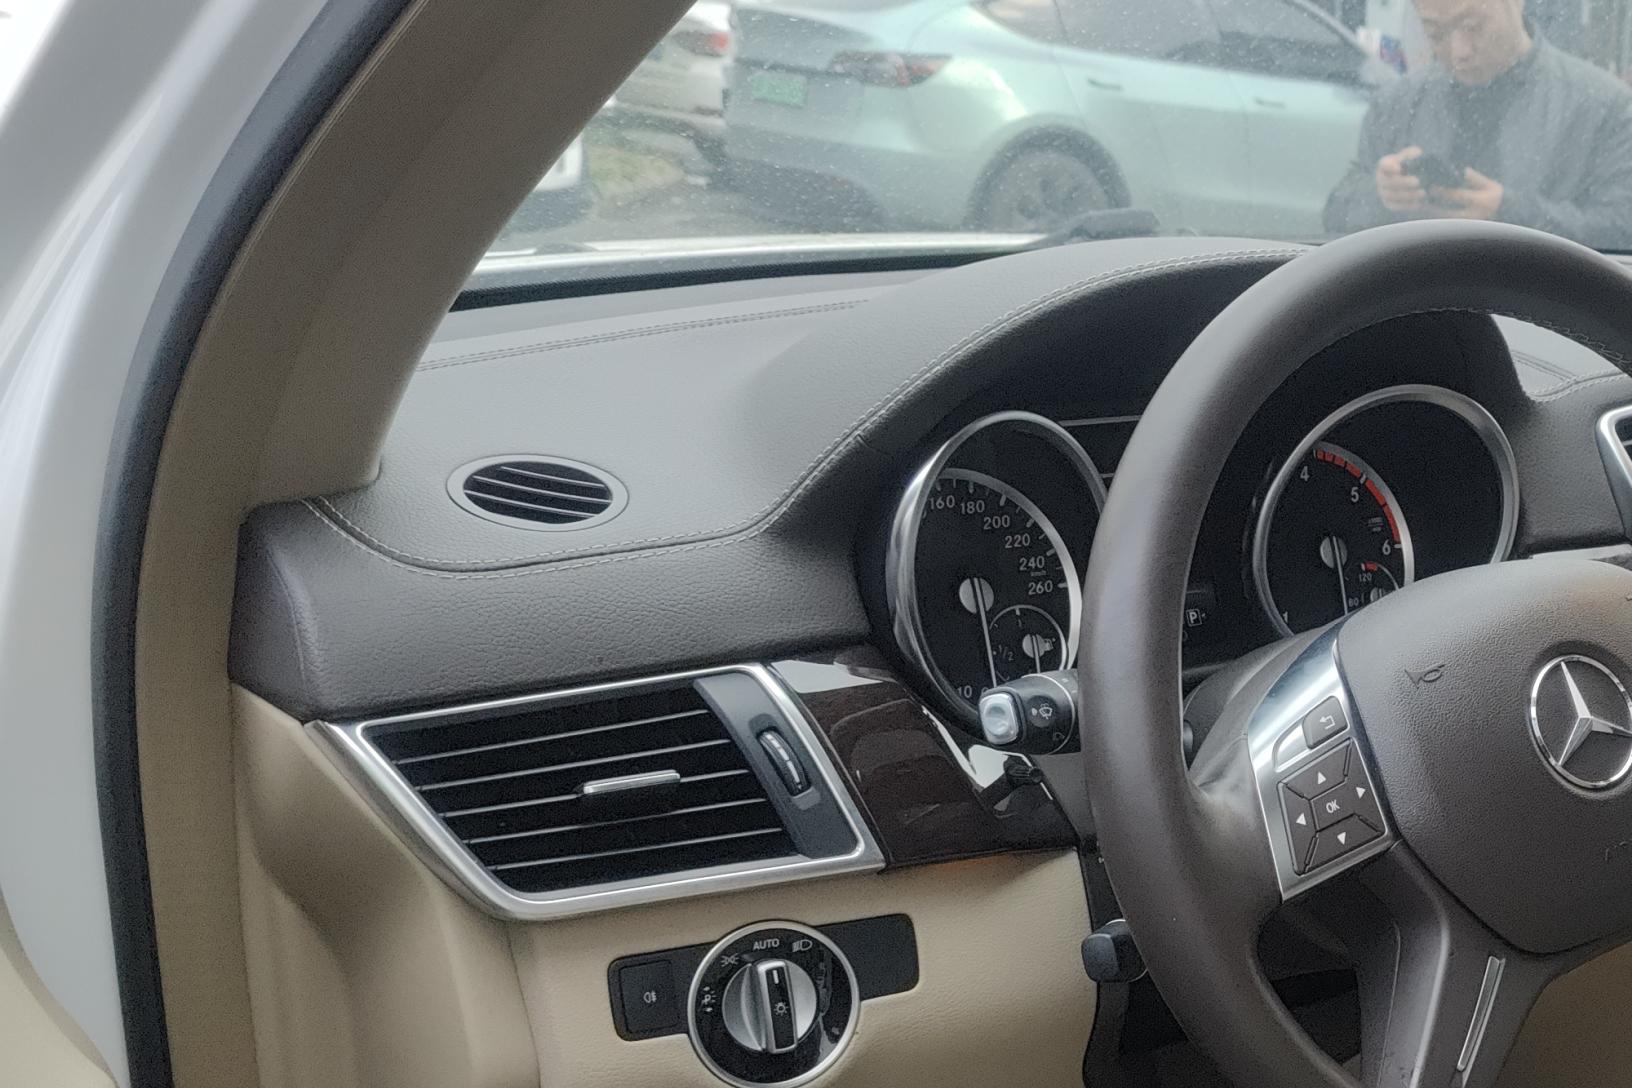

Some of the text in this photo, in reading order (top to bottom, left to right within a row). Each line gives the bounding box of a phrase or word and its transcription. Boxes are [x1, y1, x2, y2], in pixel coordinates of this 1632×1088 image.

[1300, 465, 1310, 482] 4
[929, 494, 955, 510] 160
[1350, 486, 1360, 503] 5
[960, 499, 985, 515] 180
[983, 514, 1010, 530] 200
[1004, 533, 1031, 549] 220
[1381, 539, 1391, 556] 6
[1018, 555, 1045, 571] 240
[1358, 572, 1373, 583] 120
[1027, 580, 1053, 596] 260
[1325, 799, 1341, 814] OK
[752, 938, 780, 951] AUTO
